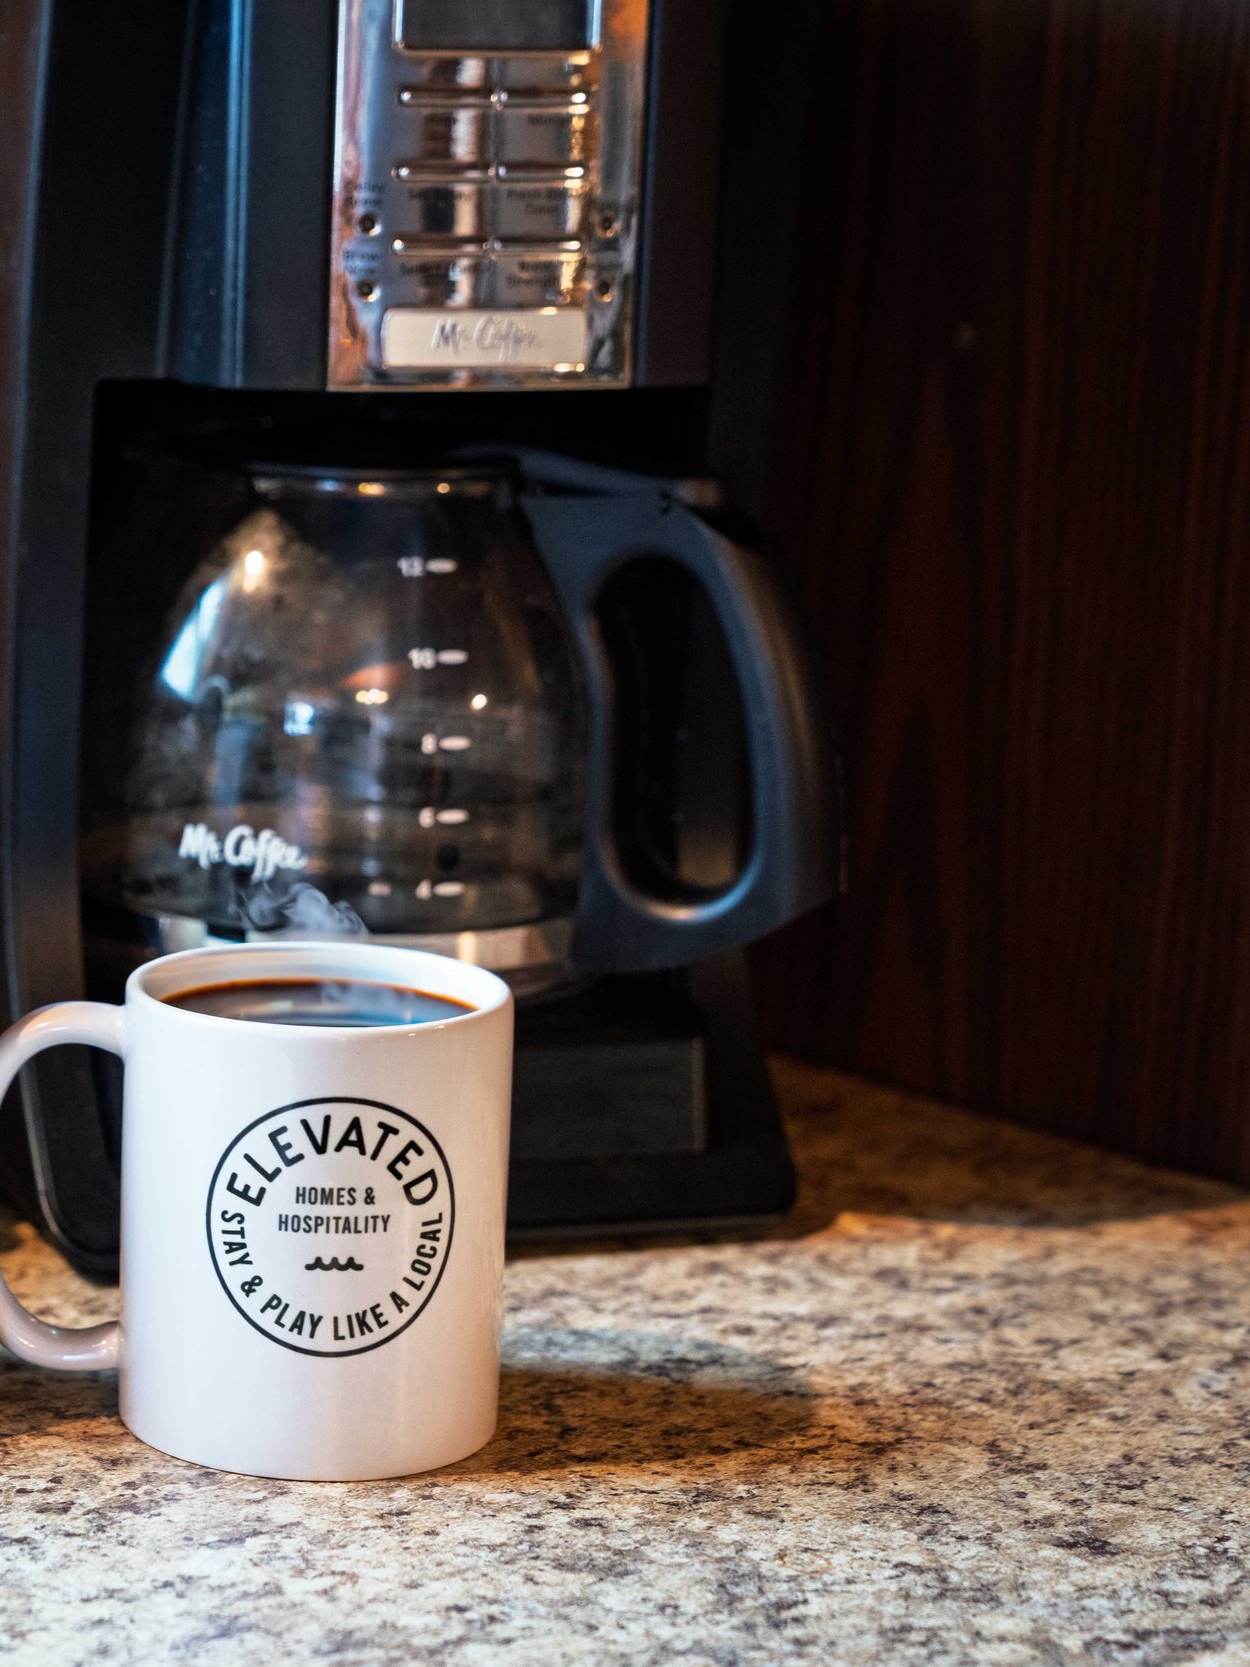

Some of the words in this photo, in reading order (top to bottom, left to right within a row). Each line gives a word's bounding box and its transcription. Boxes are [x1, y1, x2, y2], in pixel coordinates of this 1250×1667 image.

[223, 824, 308, 882] Coffee
[226, 1114, 439, 1207] ELEVATED
[278, 1213, 391, 1234] HOSPITALITY
[295, 1186, 357, 1206] HOMES
[363, 1186, 376, 1205] &
[220, 1209, 254, 1267] STAY
[240, 1275, 263, 1298] &
[259, 1293, 324, 1339] PLAY
[333, 1303, 389, 1341] LIKE
[389, 1290, 410, 1314] A
[402, 1212, 443, 1291] LOCAL
